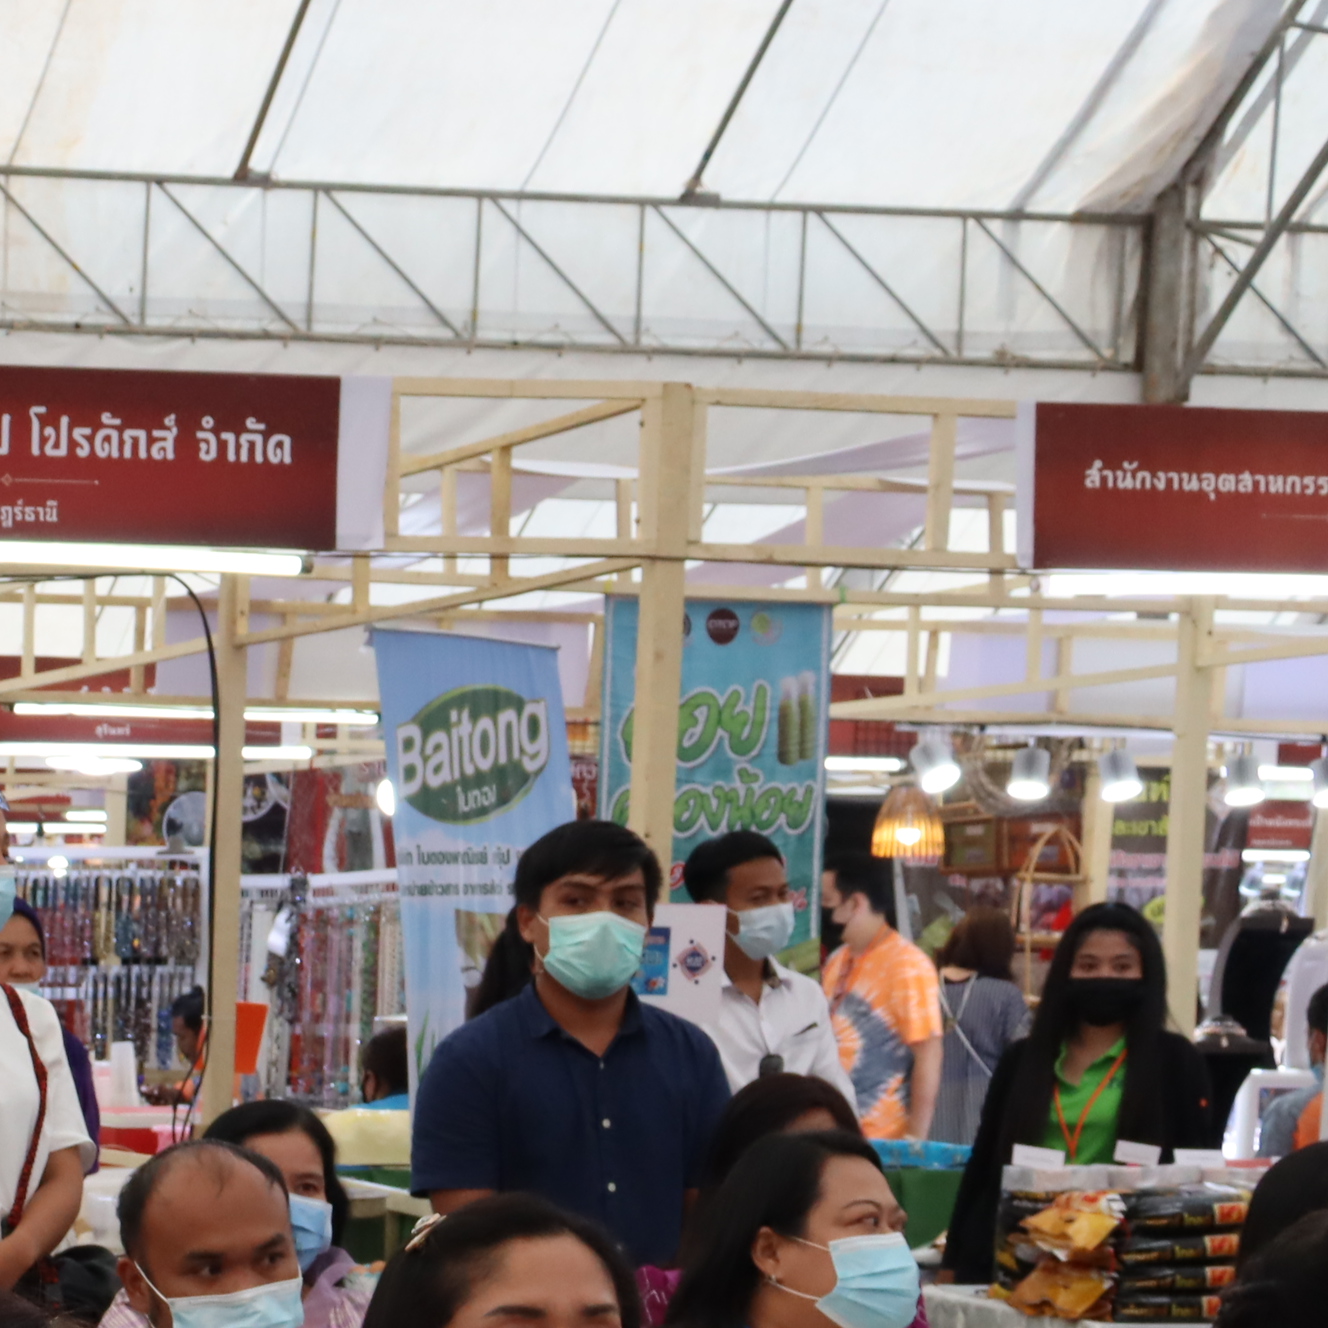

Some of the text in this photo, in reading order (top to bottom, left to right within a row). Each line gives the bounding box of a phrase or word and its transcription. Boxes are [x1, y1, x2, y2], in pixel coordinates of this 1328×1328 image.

[29, 405, 180, 463] โปรดักส์
[196, 416, 294, 466] จำกัด
[396, 699, 549, 799] Baitong
